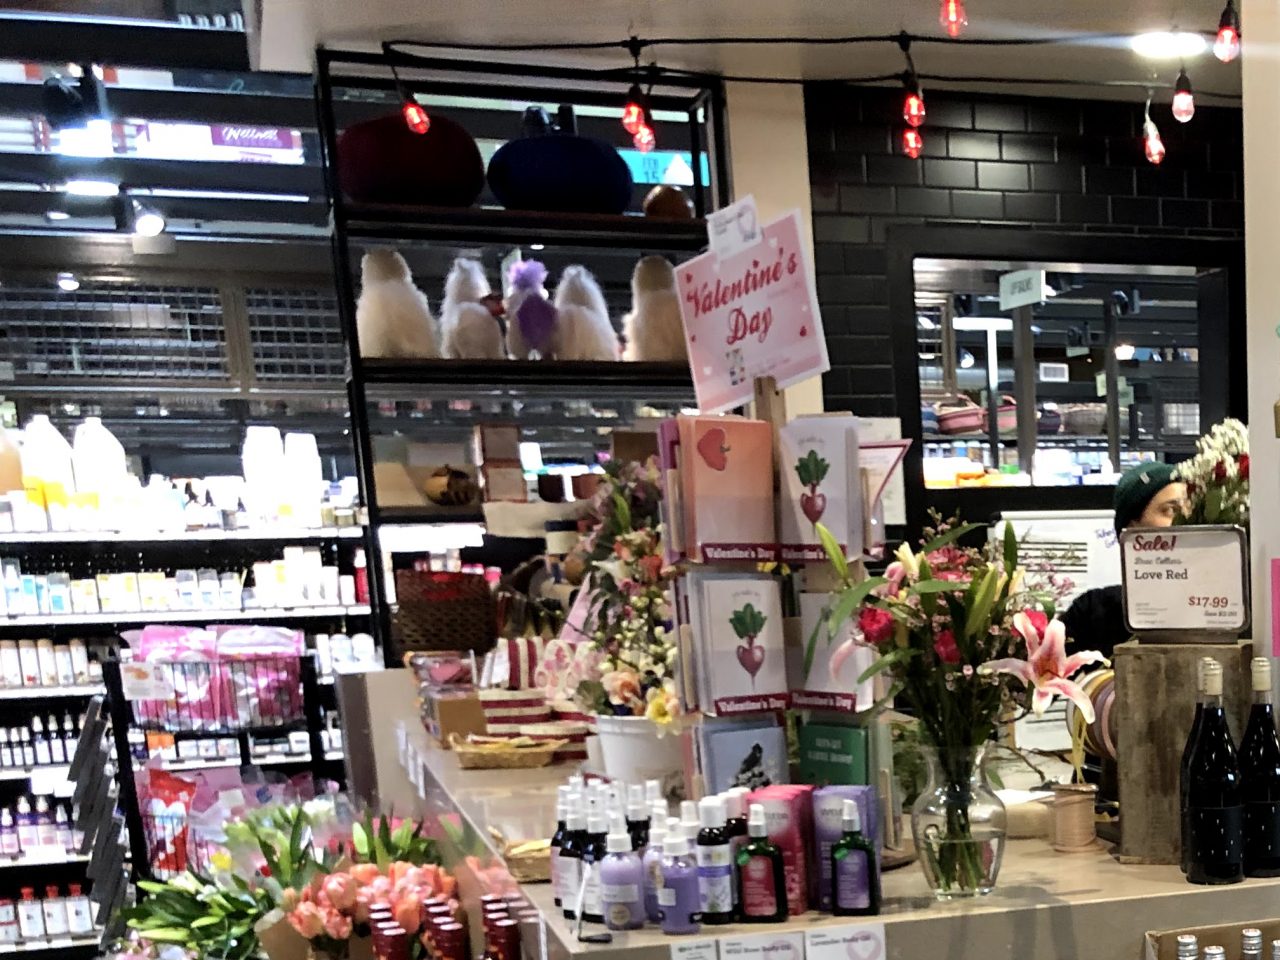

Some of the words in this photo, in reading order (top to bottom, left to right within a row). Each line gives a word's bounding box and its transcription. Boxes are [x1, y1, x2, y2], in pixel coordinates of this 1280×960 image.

[686, 248, 798, 318] Valentine's
[726, 307, 773, 346] Day
[1132, 534, 1177, 551] Sale!
[705, 547, 756, 559] Valentine's
[757, 548, 775, 560] Day
[1134, 569, 1163, 580] Love
[1166, 568, 1189, 580] Red
[1188, 595, 1229, 608] $17.99
[717, 699, 768, 712] Valentine's
